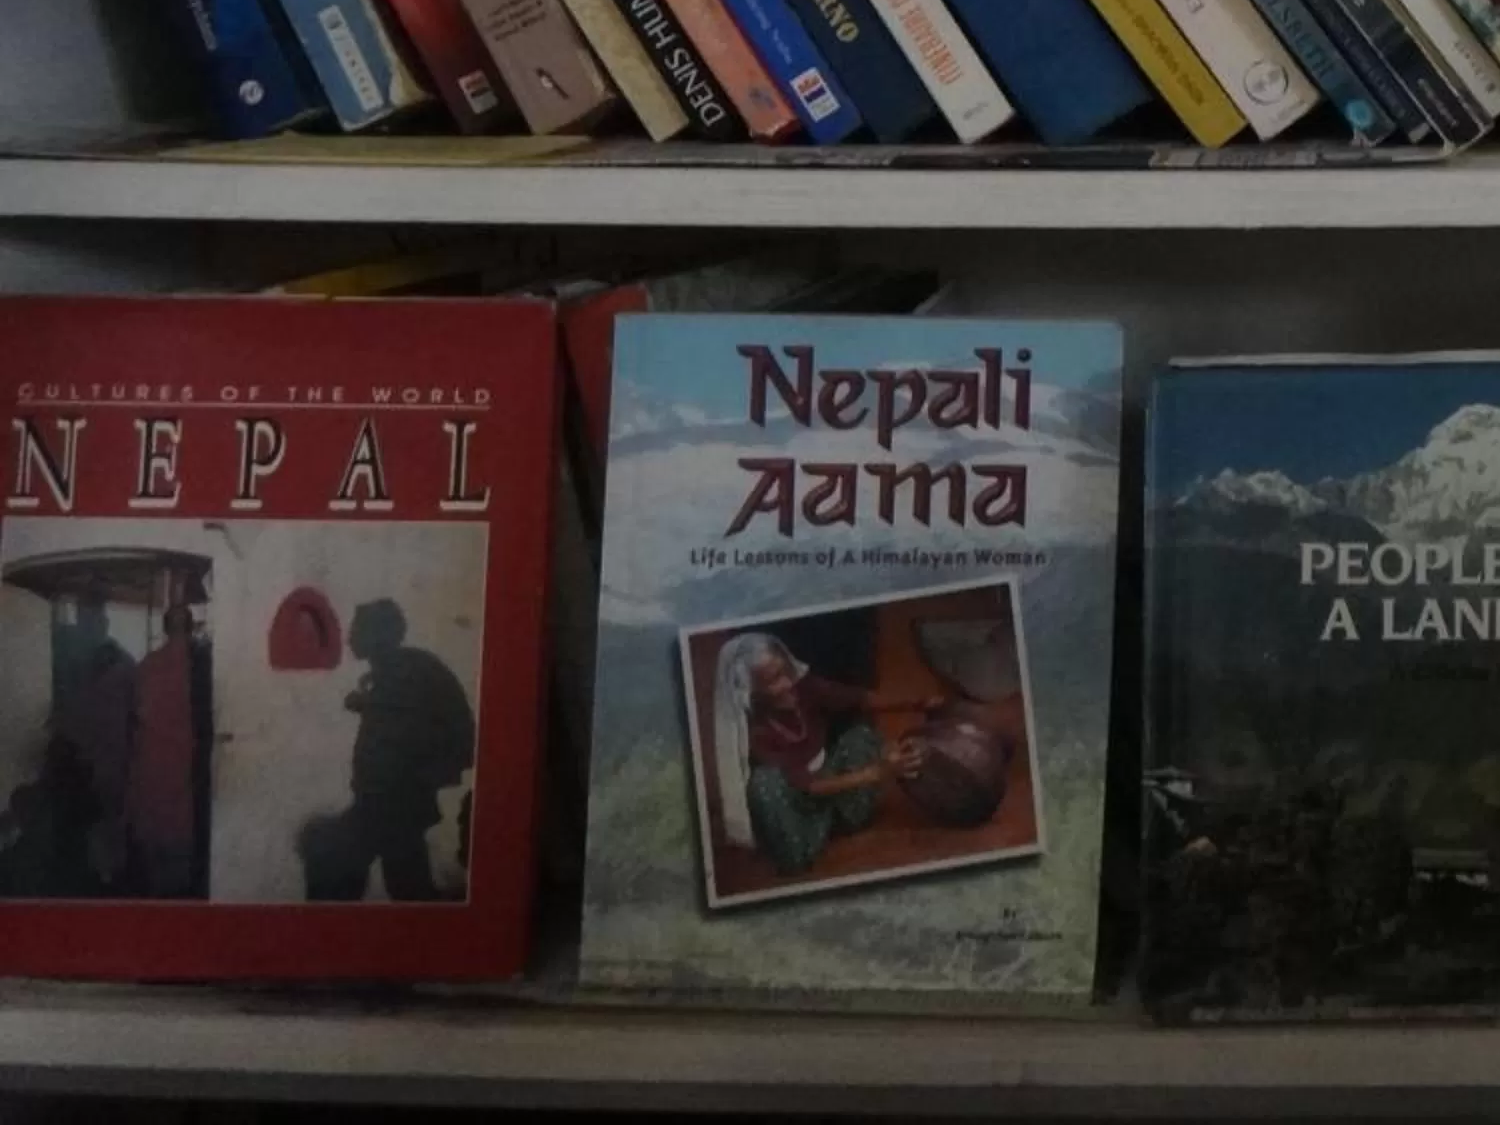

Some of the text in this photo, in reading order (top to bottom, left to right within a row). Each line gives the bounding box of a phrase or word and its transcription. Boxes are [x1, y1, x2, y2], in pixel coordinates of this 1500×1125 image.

[662, 44, 727, 129] DENIS
[17, 383, 492, 404] CULTURES OF THE WORLD
[735, 343, 1033, 452] Nepali
[5, 415, 493, 513] NEPAL
[723, 456, 1029, 539] Aama
[690, 547, 1047, 570] Life Lessons of A Himalayan Woman
[1318, 597, 1361, 643] A
